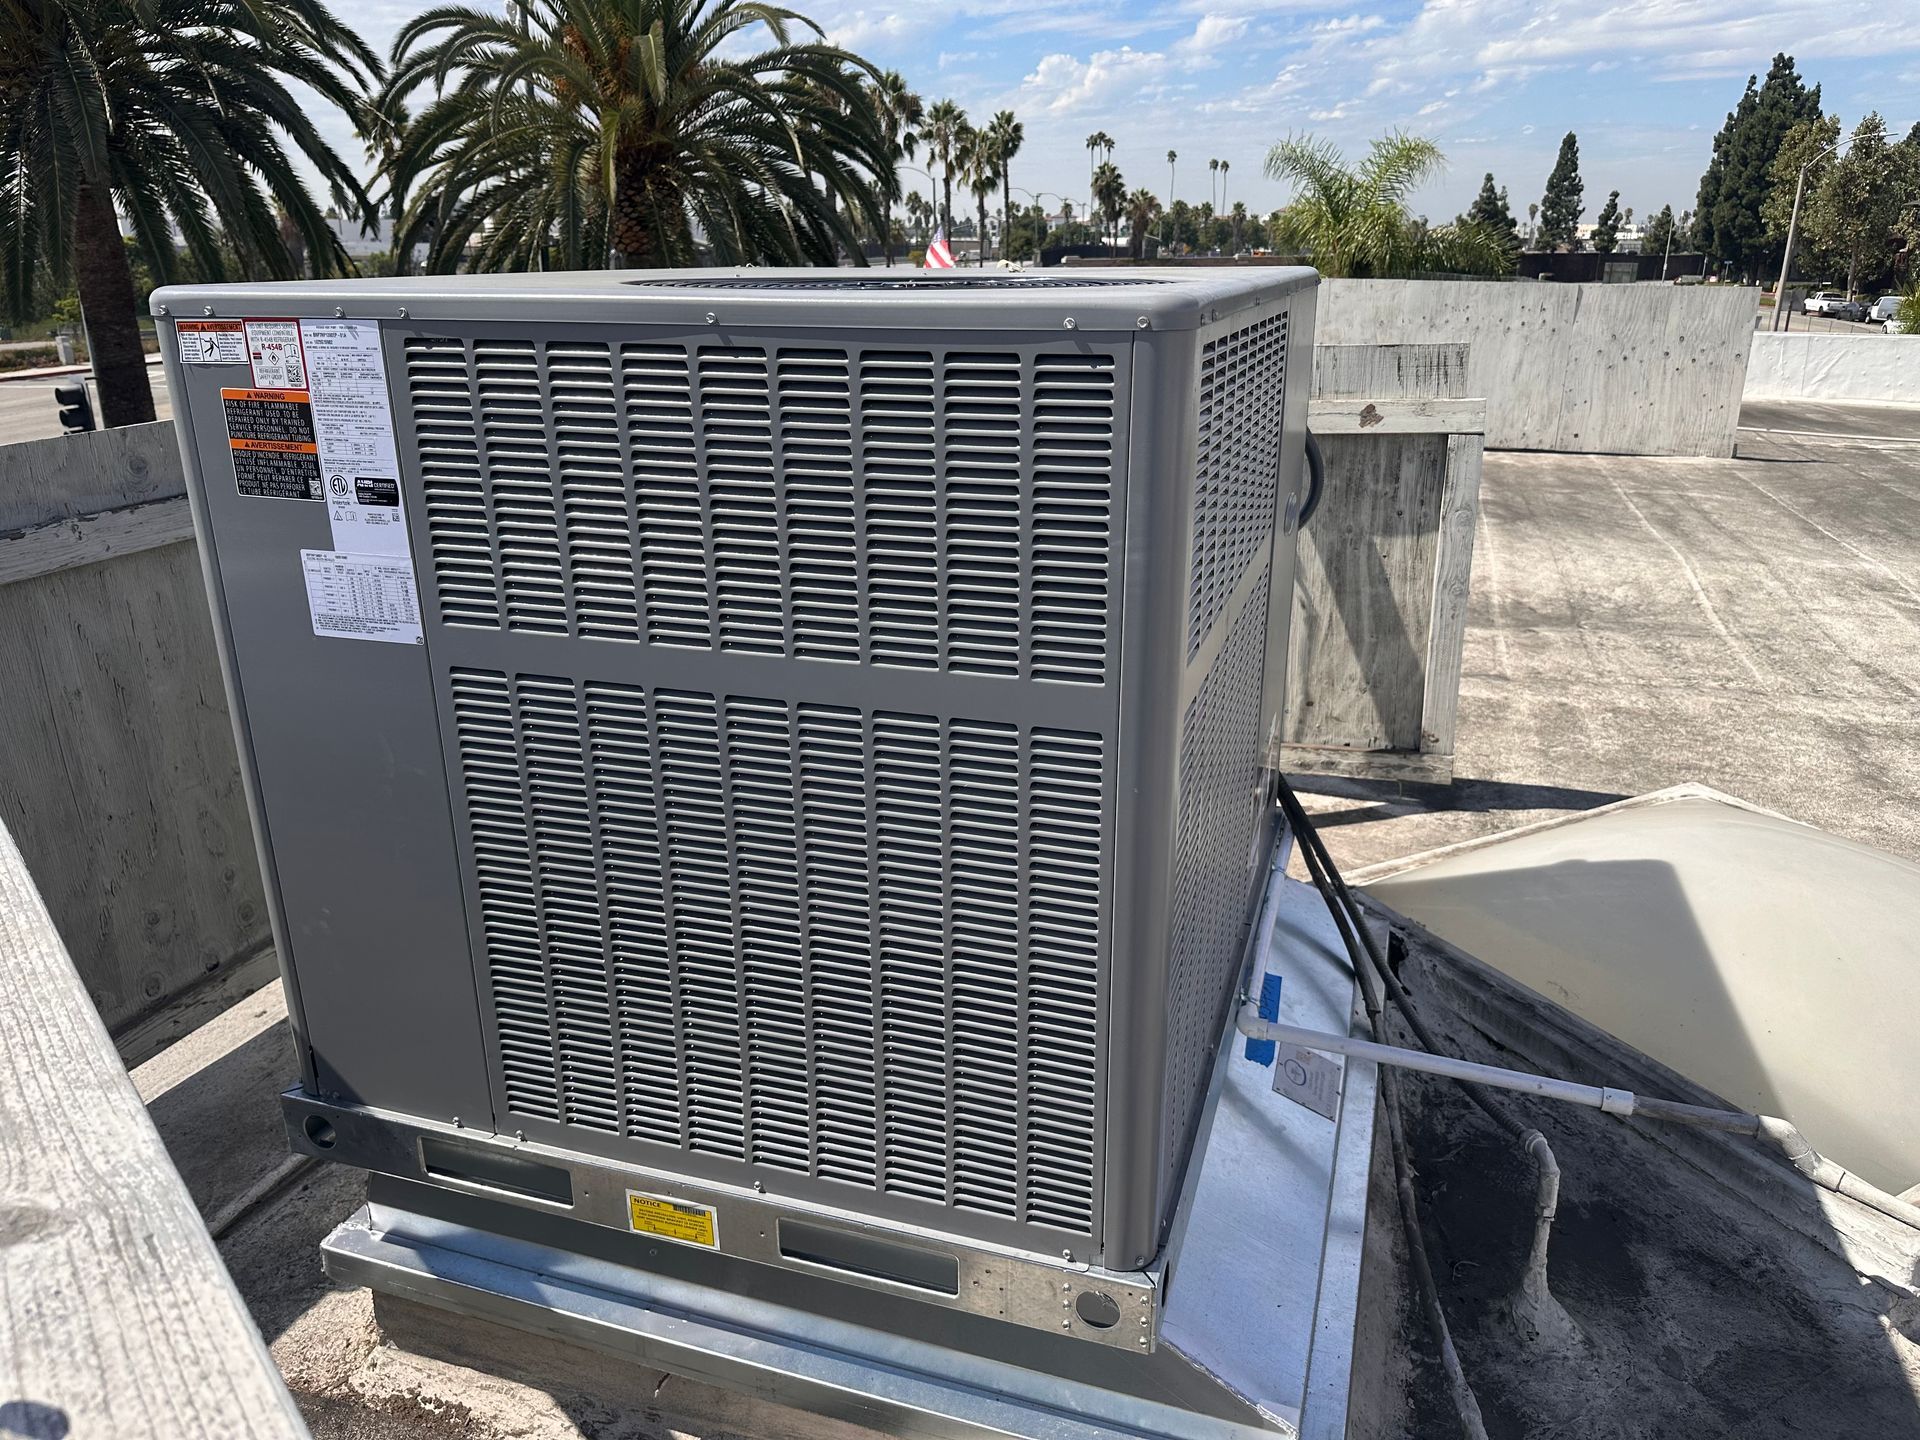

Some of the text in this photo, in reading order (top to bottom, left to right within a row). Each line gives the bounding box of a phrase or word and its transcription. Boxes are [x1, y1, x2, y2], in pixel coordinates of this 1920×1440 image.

[264, 402, 299, 410] FLAMMABLE
[226, 408, 263, 416] REFRIGERANT
[280, 418, 305, 426] TRAINED
[229, 423, 252, 431] SERVICE
[257, 432, 291, 440] REFRIGERANT
[251, 442, 303, 450] AVERTISSEMENT
[234, 450, 252, 458] RISQUE
[281, 467, 317, 476] D'ENTRETIEN
[634, 1198, 661, 1208] NOTICE
